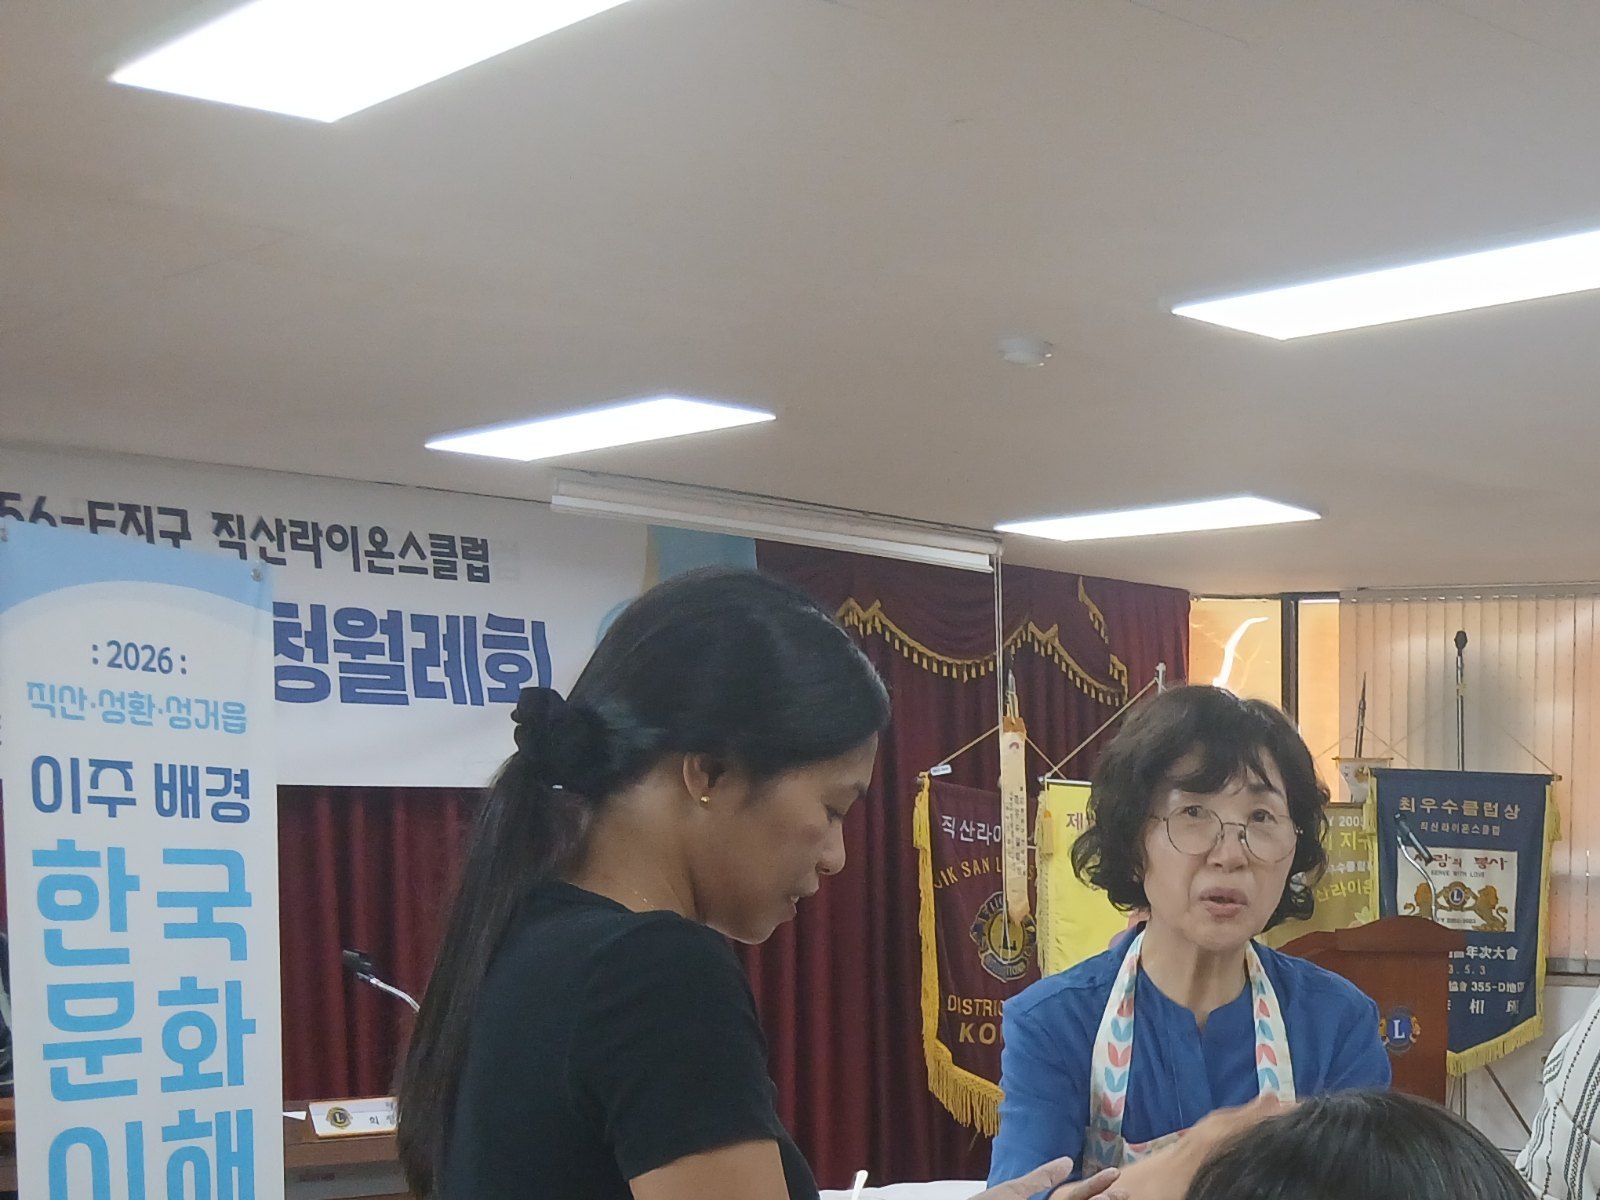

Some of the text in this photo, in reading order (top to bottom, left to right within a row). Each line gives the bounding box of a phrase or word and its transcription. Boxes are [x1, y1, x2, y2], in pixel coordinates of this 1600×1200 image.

[210, 511, 491, 584] 직산라이온스클럽
[31, 755, 250, 824] 이주 배경
[1398, 796, 1520, 820] 최우수클럽상
[960, 857, 990, 878] SAN
[32, 838, 252, 967] 한국
[42, 976, 256, 1102] 문화
[959, 1022, 998, 1045] KO
[1393, 1019, 1405, 1039] L
